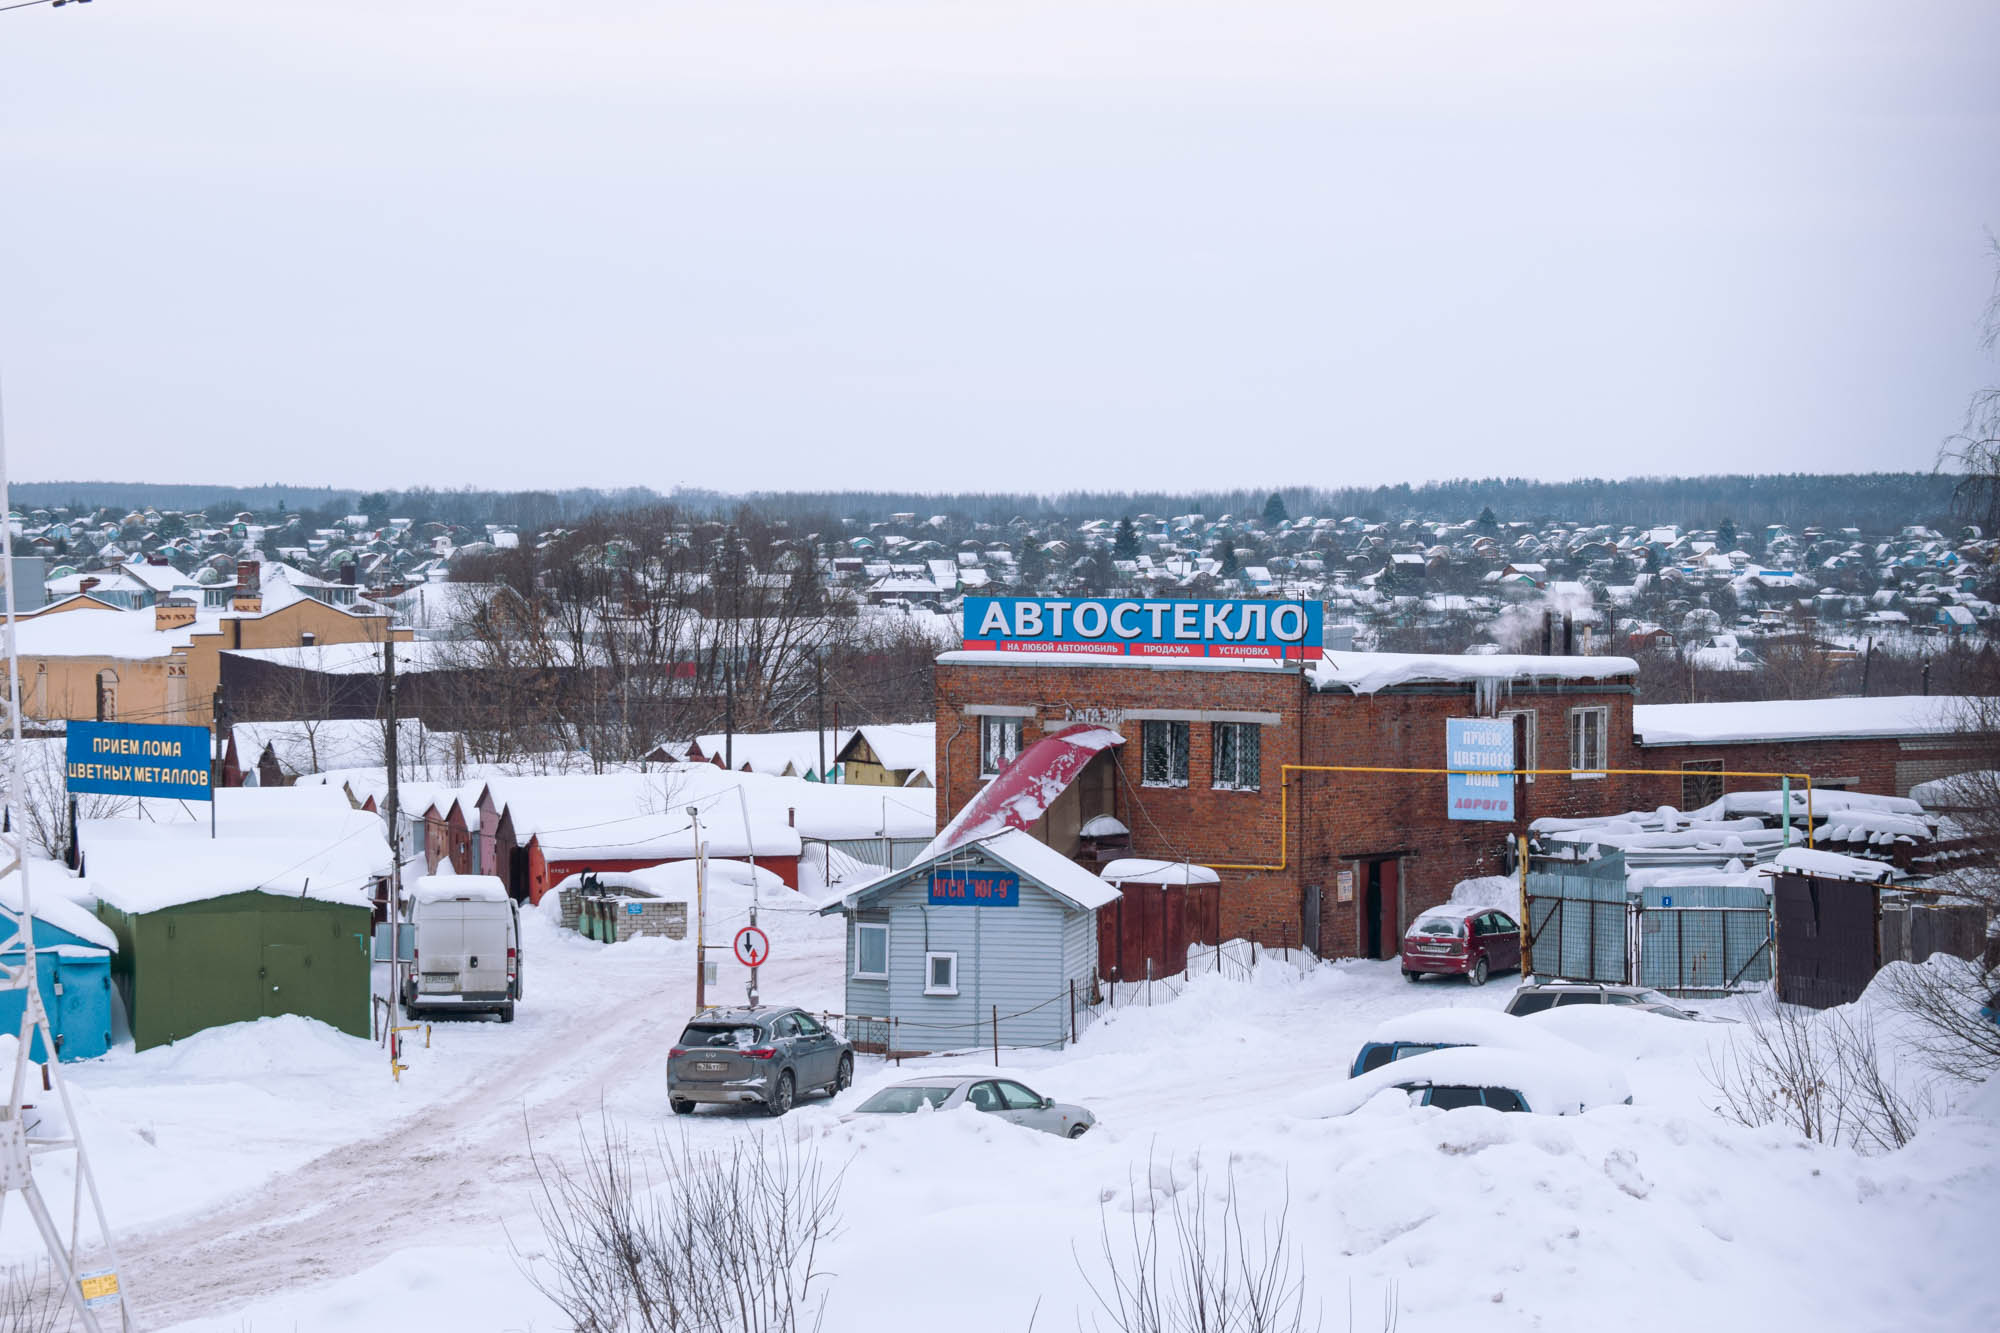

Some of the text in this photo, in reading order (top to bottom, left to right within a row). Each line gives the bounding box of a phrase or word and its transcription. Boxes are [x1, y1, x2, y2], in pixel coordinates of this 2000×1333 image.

[978, 601, 1309, 642] АВТОСТЕКЛО
[1006, 641, 1118, 653] НА ЛЮБОЙ АВТОМОБИЛЬ
[1143, 645, 1190, 655] ПРОДАЖА
[1218, 646, 1269, 656] УСТАНОВКА
[1464, 731, 1502, 745] ПРИЕМ
[93, 737, 182, 757] ПРИЕМ ЛОМА
[1454, 751, 1511, 767] ЦВЕТНОГО
[68, 762, 208, 786] ЦВЕТНЫХ МЕТАЛЛОВ
[1466, 773, 1499, 787] ЛОМА
[1454, 798, 1508, 811] ДОРОГО
